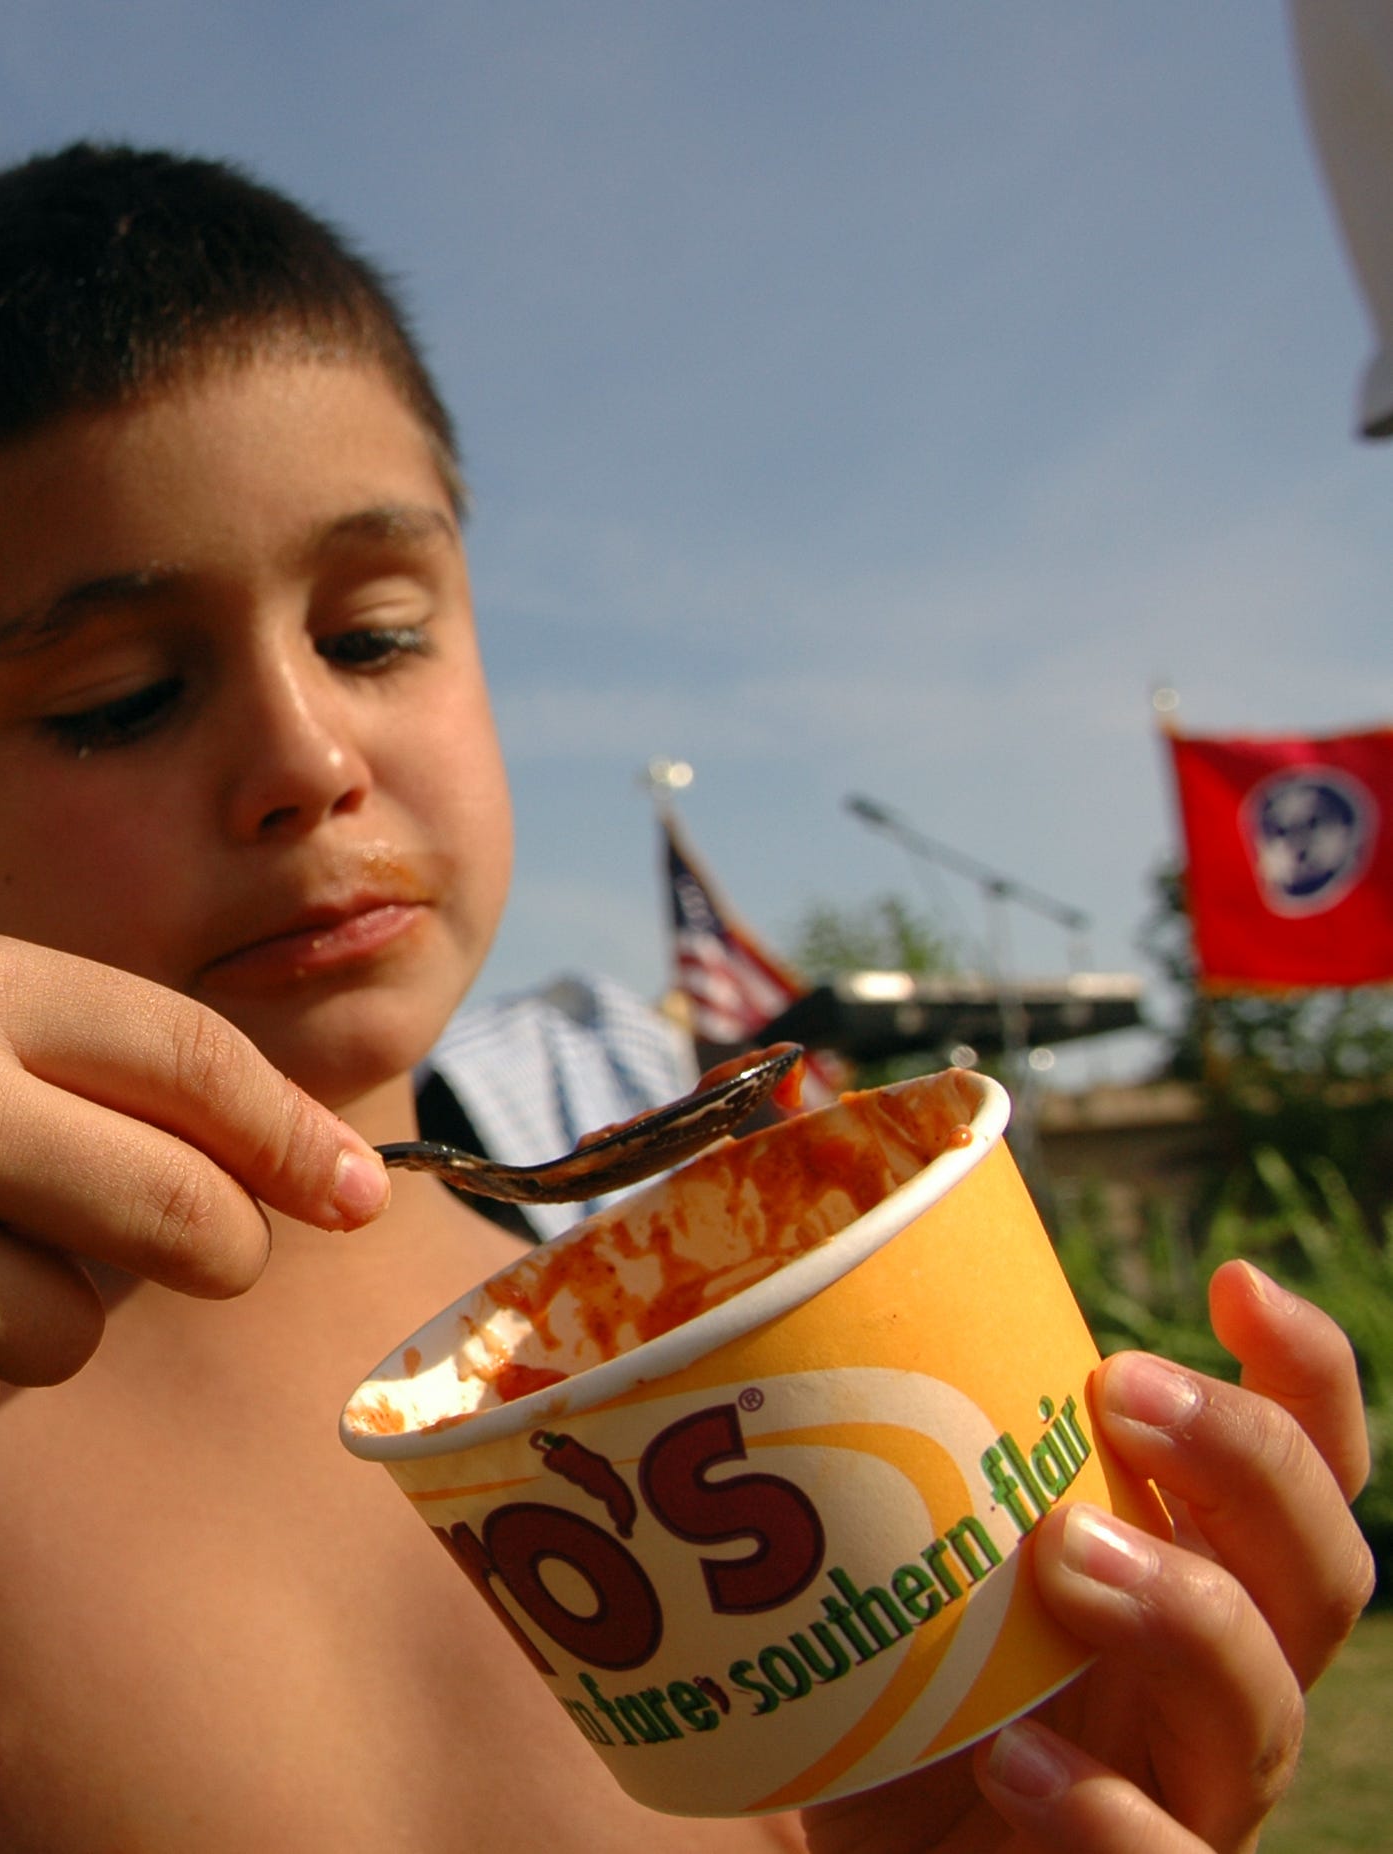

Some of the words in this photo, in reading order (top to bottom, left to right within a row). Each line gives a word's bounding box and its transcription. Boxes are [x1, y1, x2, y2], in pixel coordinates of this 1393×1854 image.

[578, 1672, 720, 1746] fare
[728, 1515, 1003, 1716] southern
[980, 1394, 1092, 1543] flair
